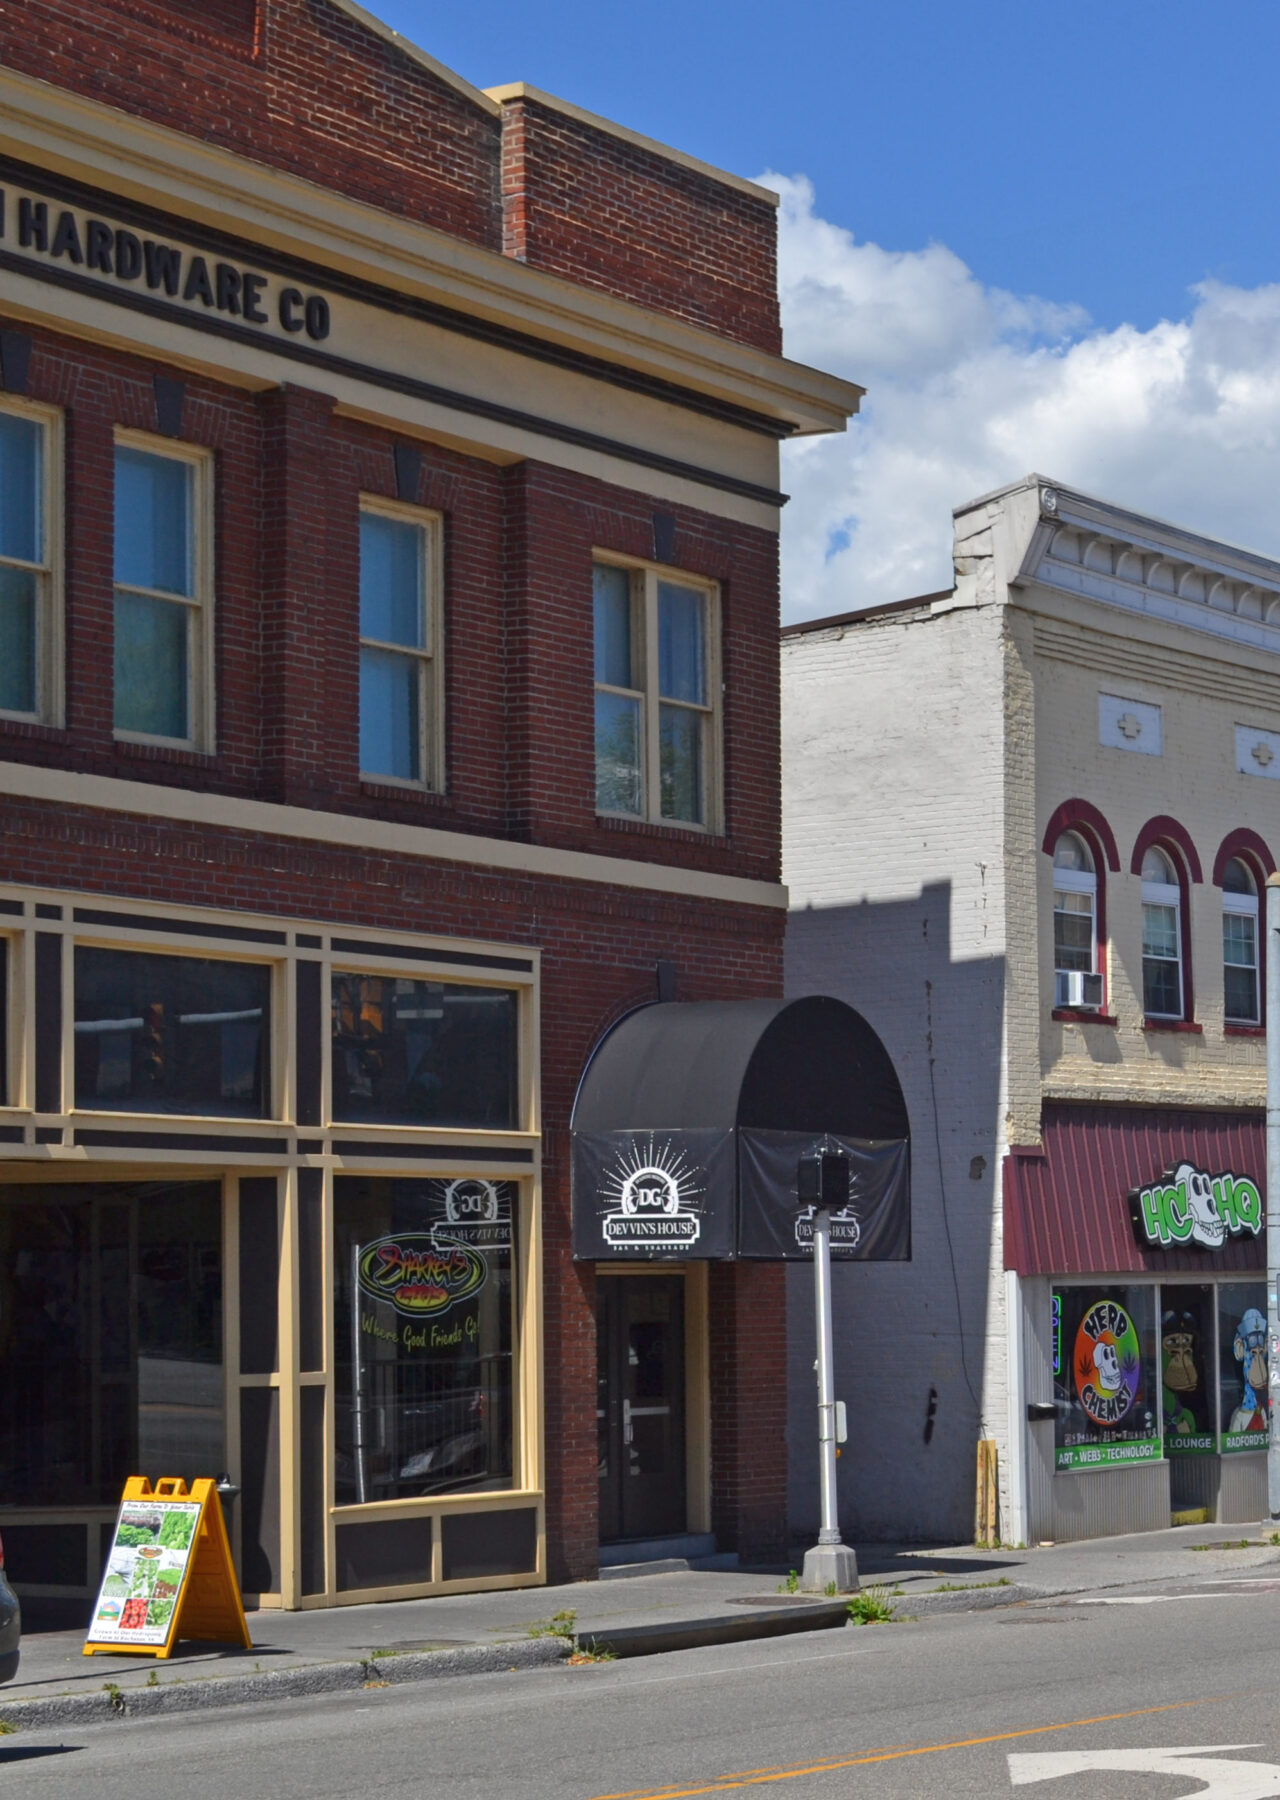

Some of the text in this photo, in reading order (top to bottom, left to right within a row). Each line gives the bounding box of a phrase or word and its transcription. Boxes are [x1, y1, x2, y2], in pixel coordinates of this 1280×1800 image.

[19, 197, 269, 325] HARDWARE
[279, 287, 331, 342] CO
[639, 1188, 662, 1206] DG
[658, 1221, 695, 1235] HOUSE
[832, 1225, 857, 1238] HOUSE
[1083, 1302, 1128, 1342] HERB
[361, 1312, 398, 1343] Where
[403, 1325, 427, 1352] Good
[431, 1324, 463, 1348] Friends
[1170, 1437, 1212, 1449] LOUNGE
[1226, 1433, 1264, 1448] RADFORD'S
[1058, 1444, 1154, 1465] ART WEB3 TECHNOLOGY
